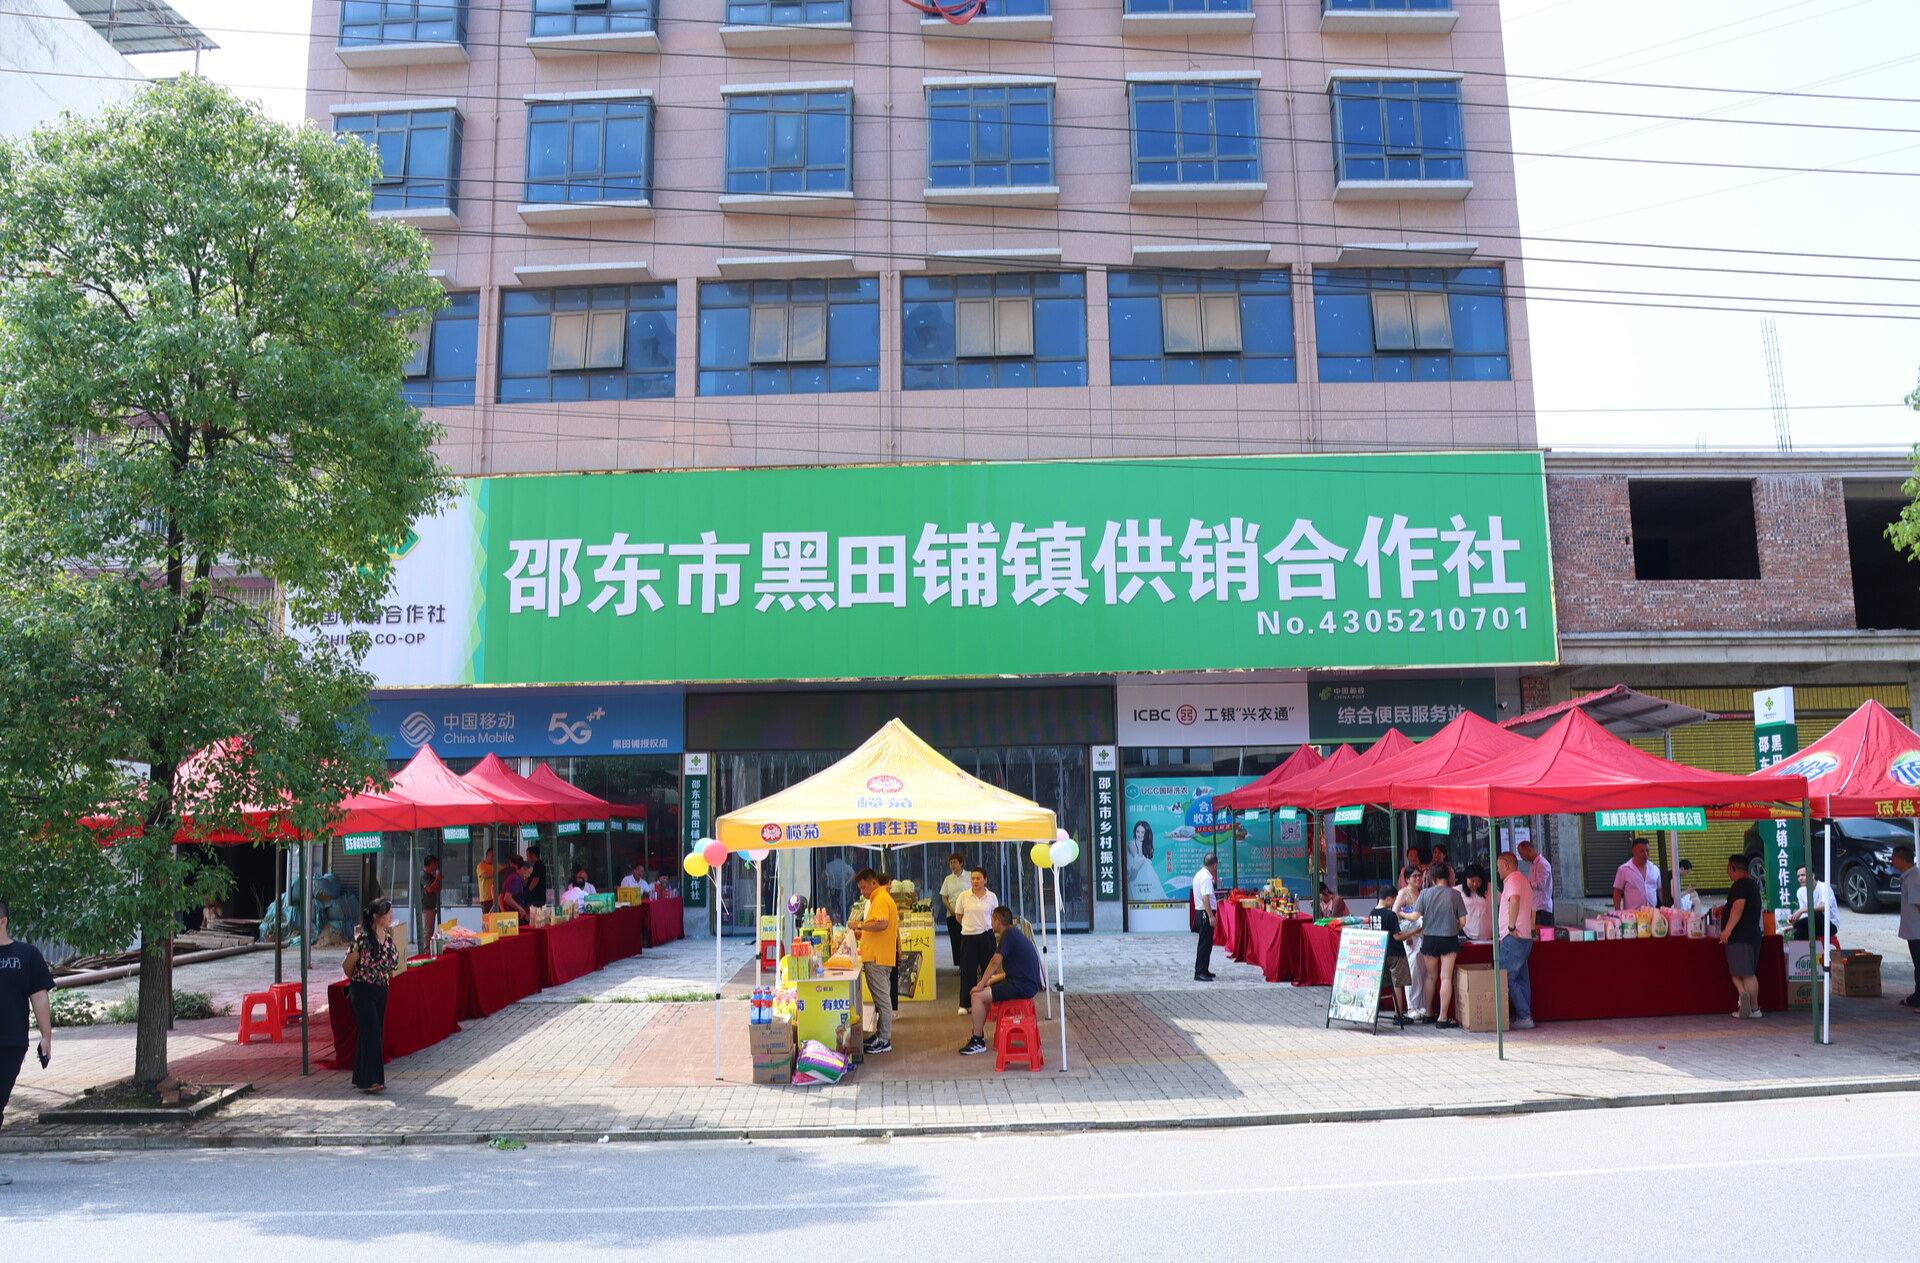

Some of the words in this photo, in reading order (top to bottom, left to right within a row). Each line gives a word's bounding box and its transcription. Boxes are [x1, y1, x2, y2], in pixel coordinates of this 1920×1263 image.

[502, 513, 1526, 617] 邵东市黑田铺镇供销合作社
[1257, 606, 1528, 635] No.4305210701
[375, 633, 426, 645] CO-OP
[1333, 687, 1365, 695] 中国邮政
[443, 711, 515, 730] 中国移动
[1133, 709, 1171, 722] ICBC
[1337, 704, 1466, 725] 综合便民服务站
[443, 732, 475, 744] China
[478, 732, 515, 743] Mobile
[612, 738, 668, 749] 黑田铺授权店
[1601, 811, 1702, 827] 湖南顶俏生物科技有限公司
[785, 823, 820, 840] 榄菊
[857, 821, 918, 837] 健康生活
[936, 821, 998, 835] 榄菊相伴
[1098, 777, 1114, 895] 邵东市乡村振兴馆
